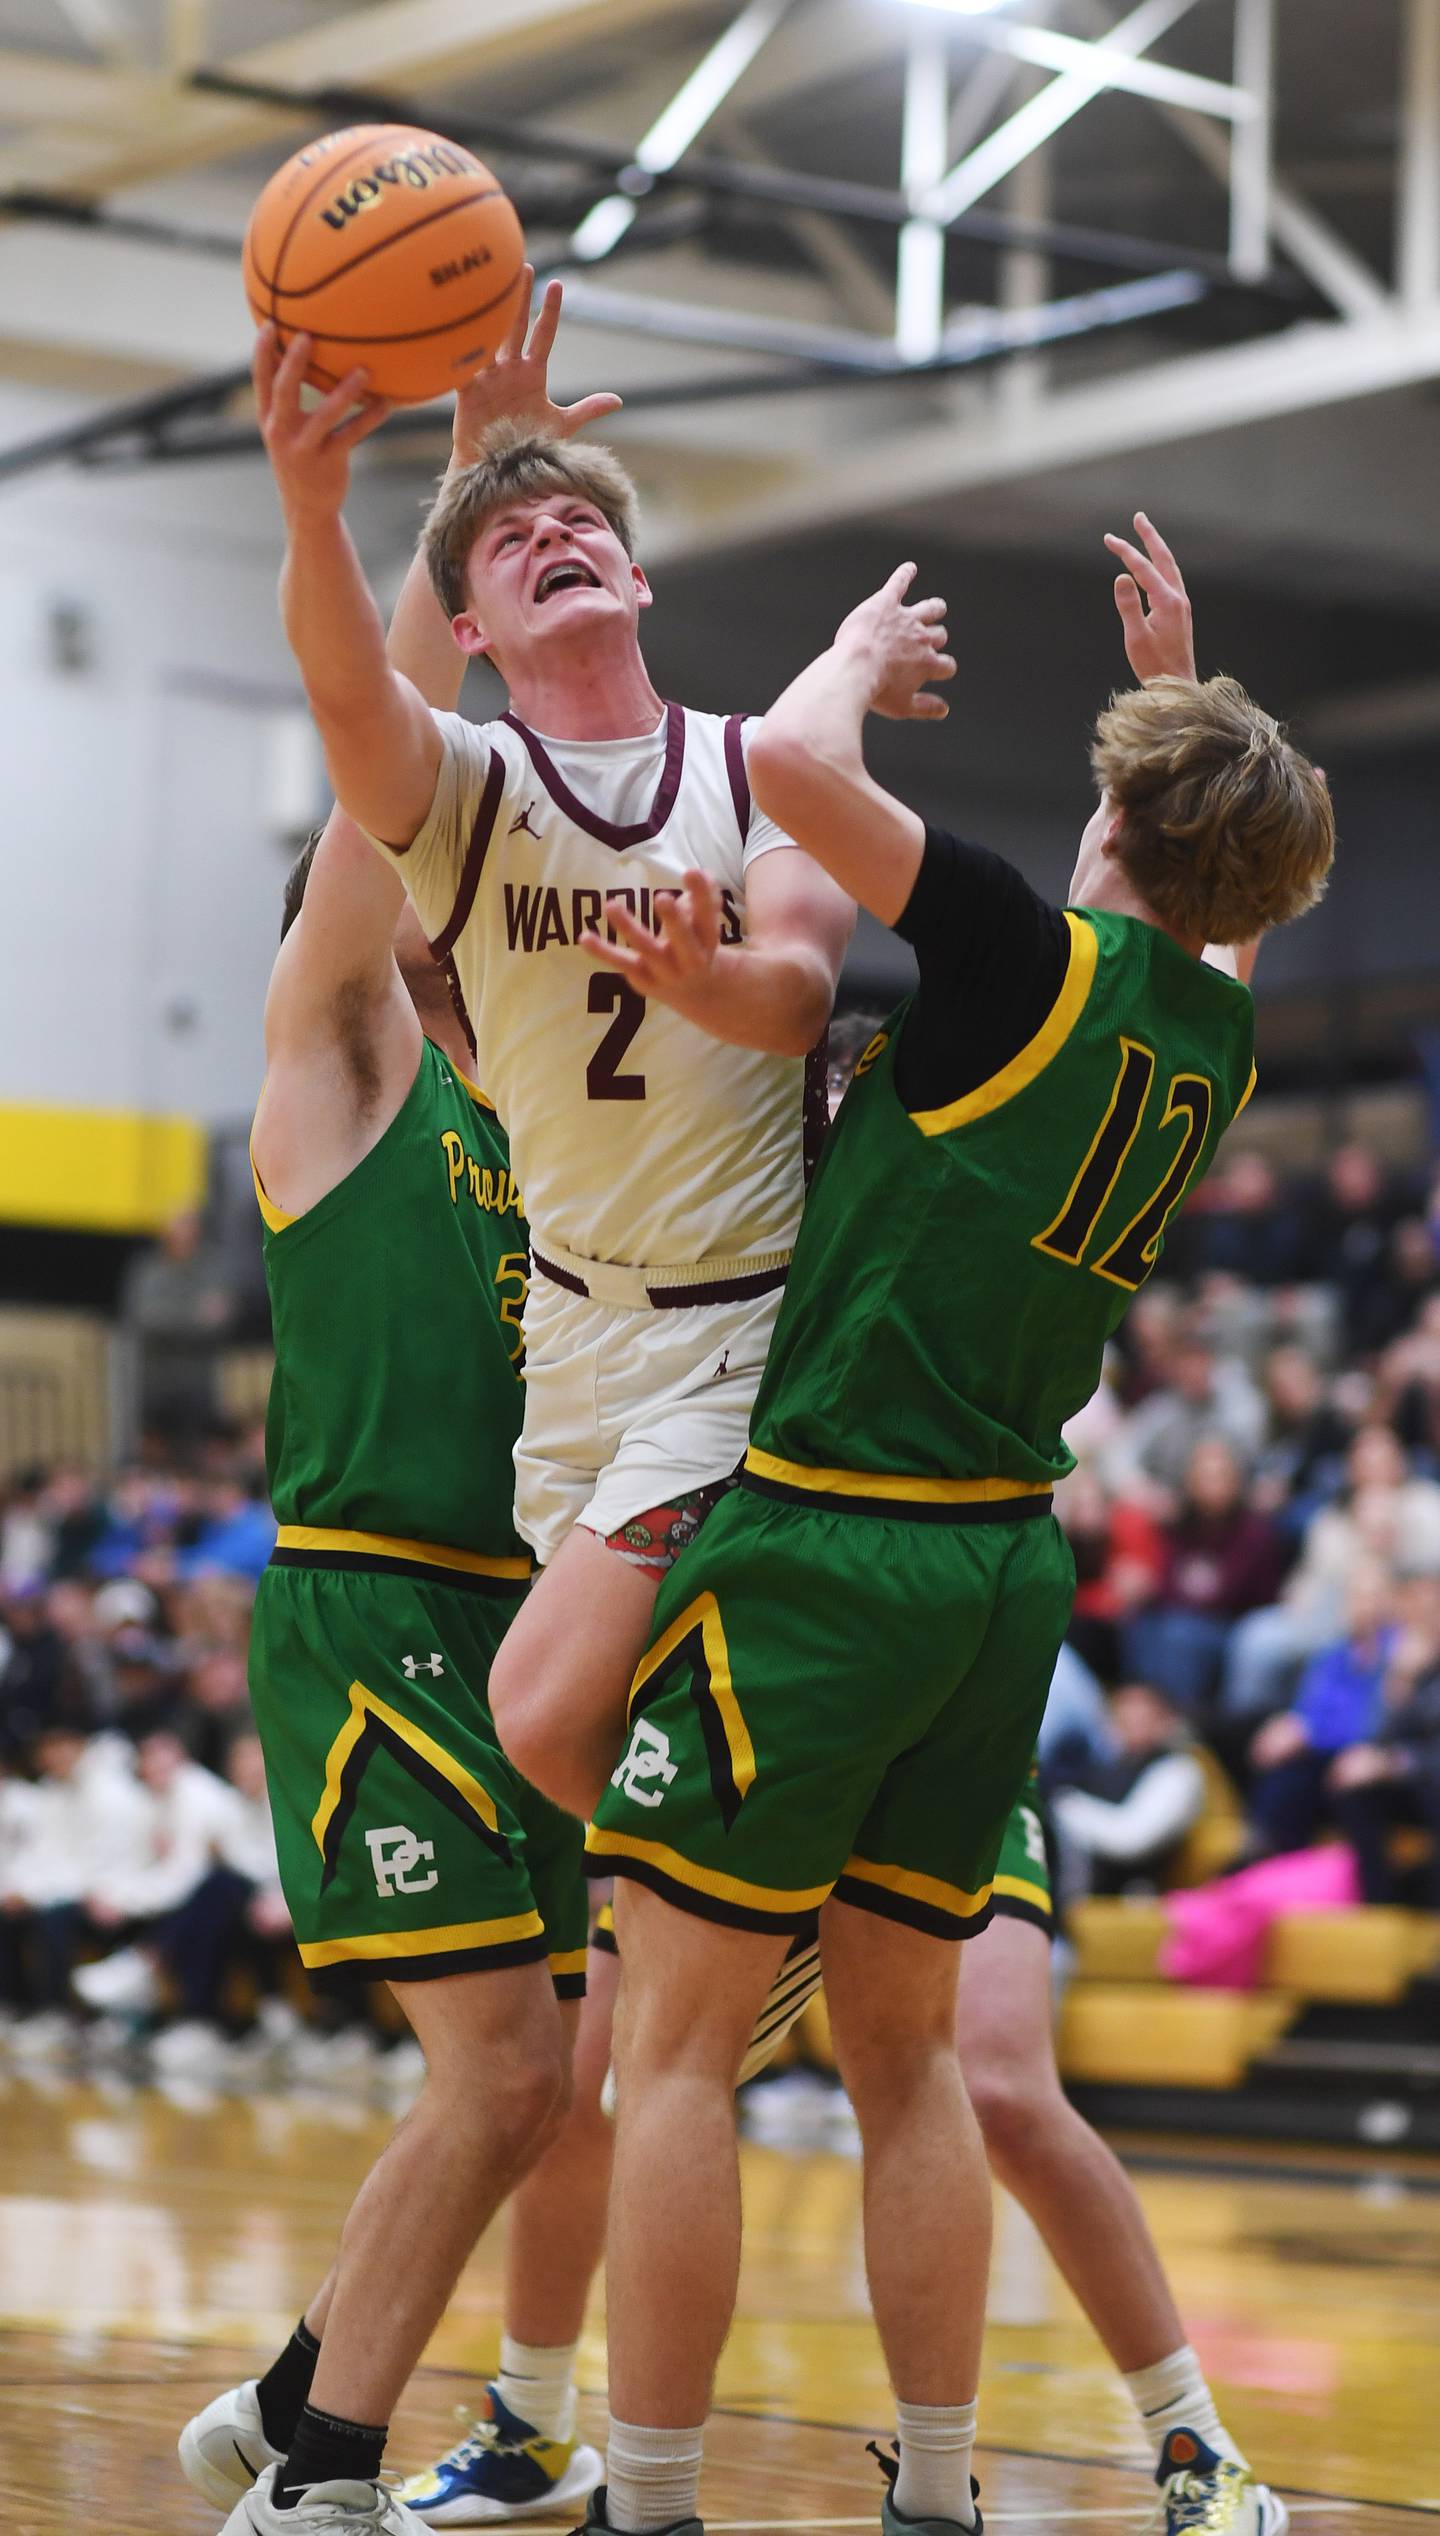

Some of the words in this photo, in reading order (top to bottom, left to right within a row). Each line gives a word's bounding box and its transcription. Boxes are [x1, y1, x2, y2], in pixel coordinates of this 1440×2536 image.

[503, 882, 744, 952] WARRIS
[586, 971, 646, 1100] 2
[1030, 1034, 1212, 1291] 12
[364, 1824, 439, 1898] PC
